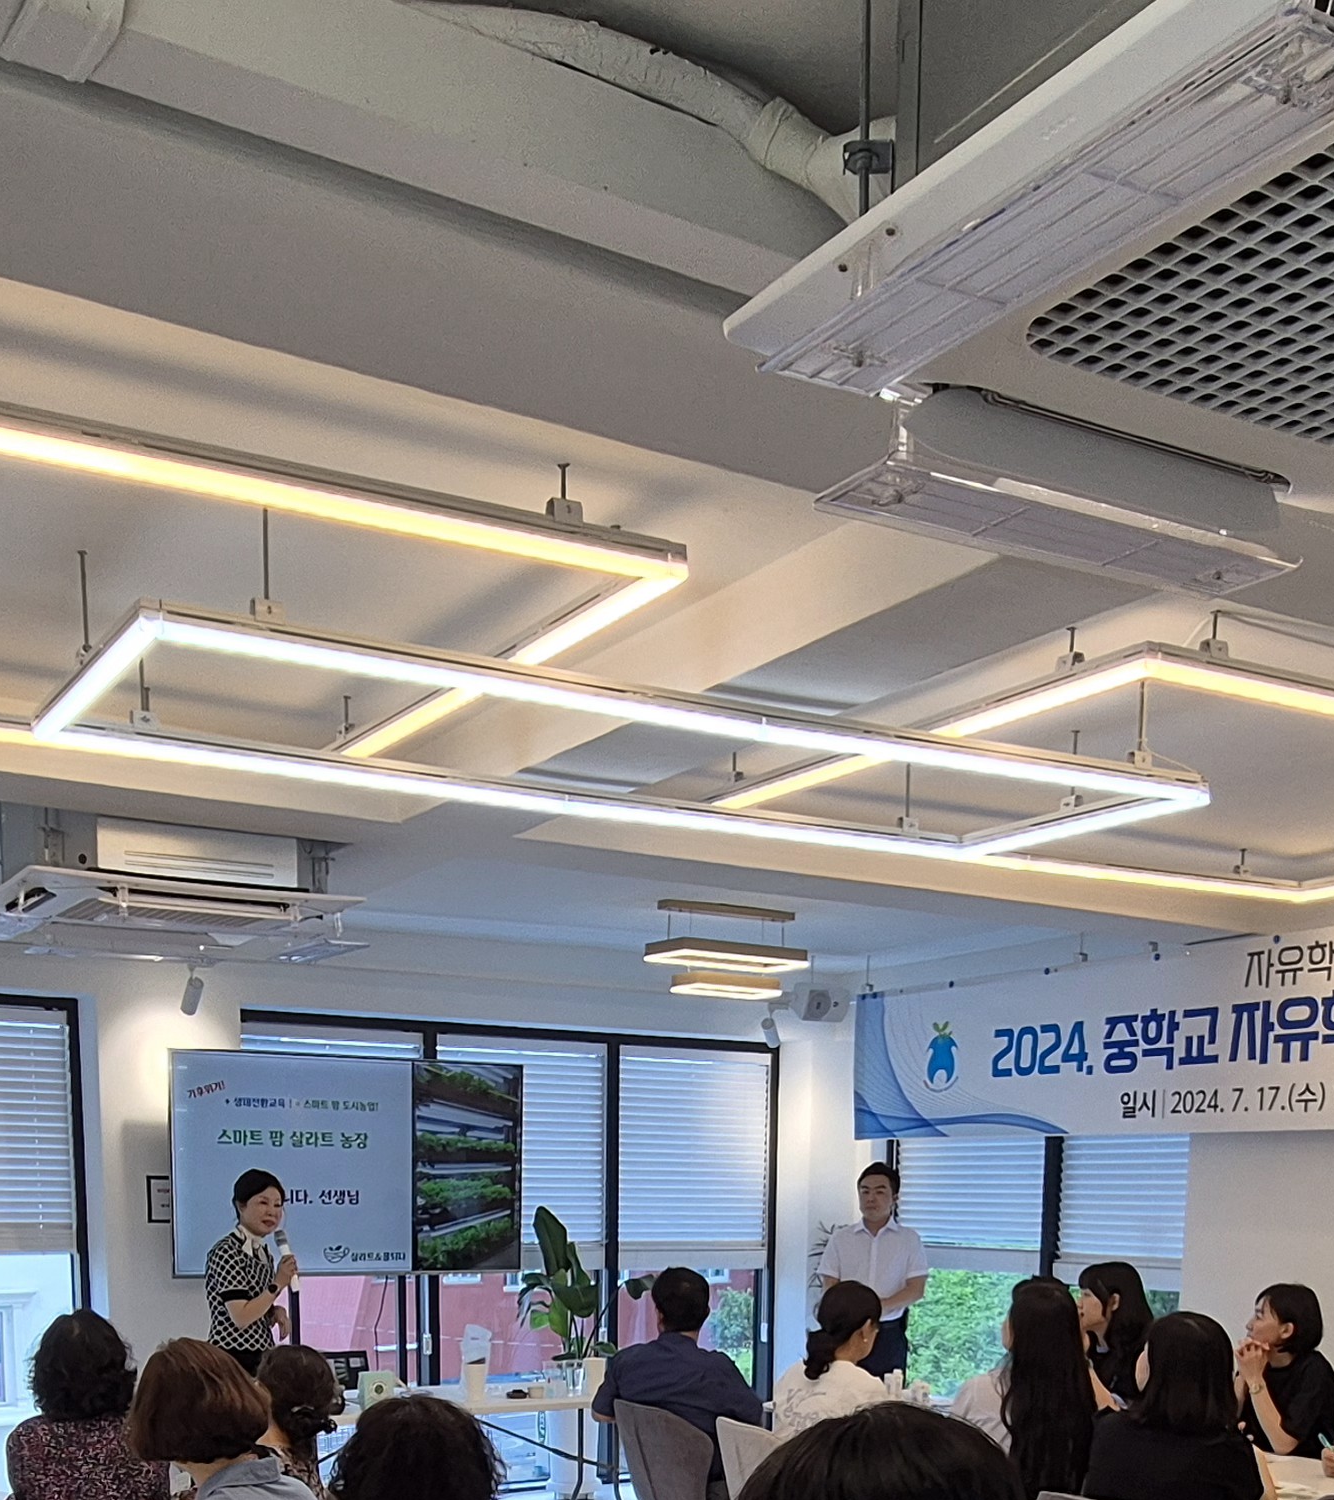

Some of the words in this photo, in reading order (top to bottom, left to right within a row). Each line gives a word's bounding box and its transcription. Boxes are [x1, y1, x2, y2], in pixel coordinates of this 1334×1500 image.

[991, 1020, 1094, 1078] 2024.
[1102, 1006, 1219, 1074] 중학교
[1119, 1090, 1156, 1119] 일시
[1170, 1088, 1225, 1115] 2024.
[217, 1128, 264, 1147] 스마트
[269, 1129, 285, 1148] 팜
[289, 1130, 335, 1149] 살라트
[340, 1131, 369, 1150] 농장
[318, 1189, 360, 1206] 선생님
